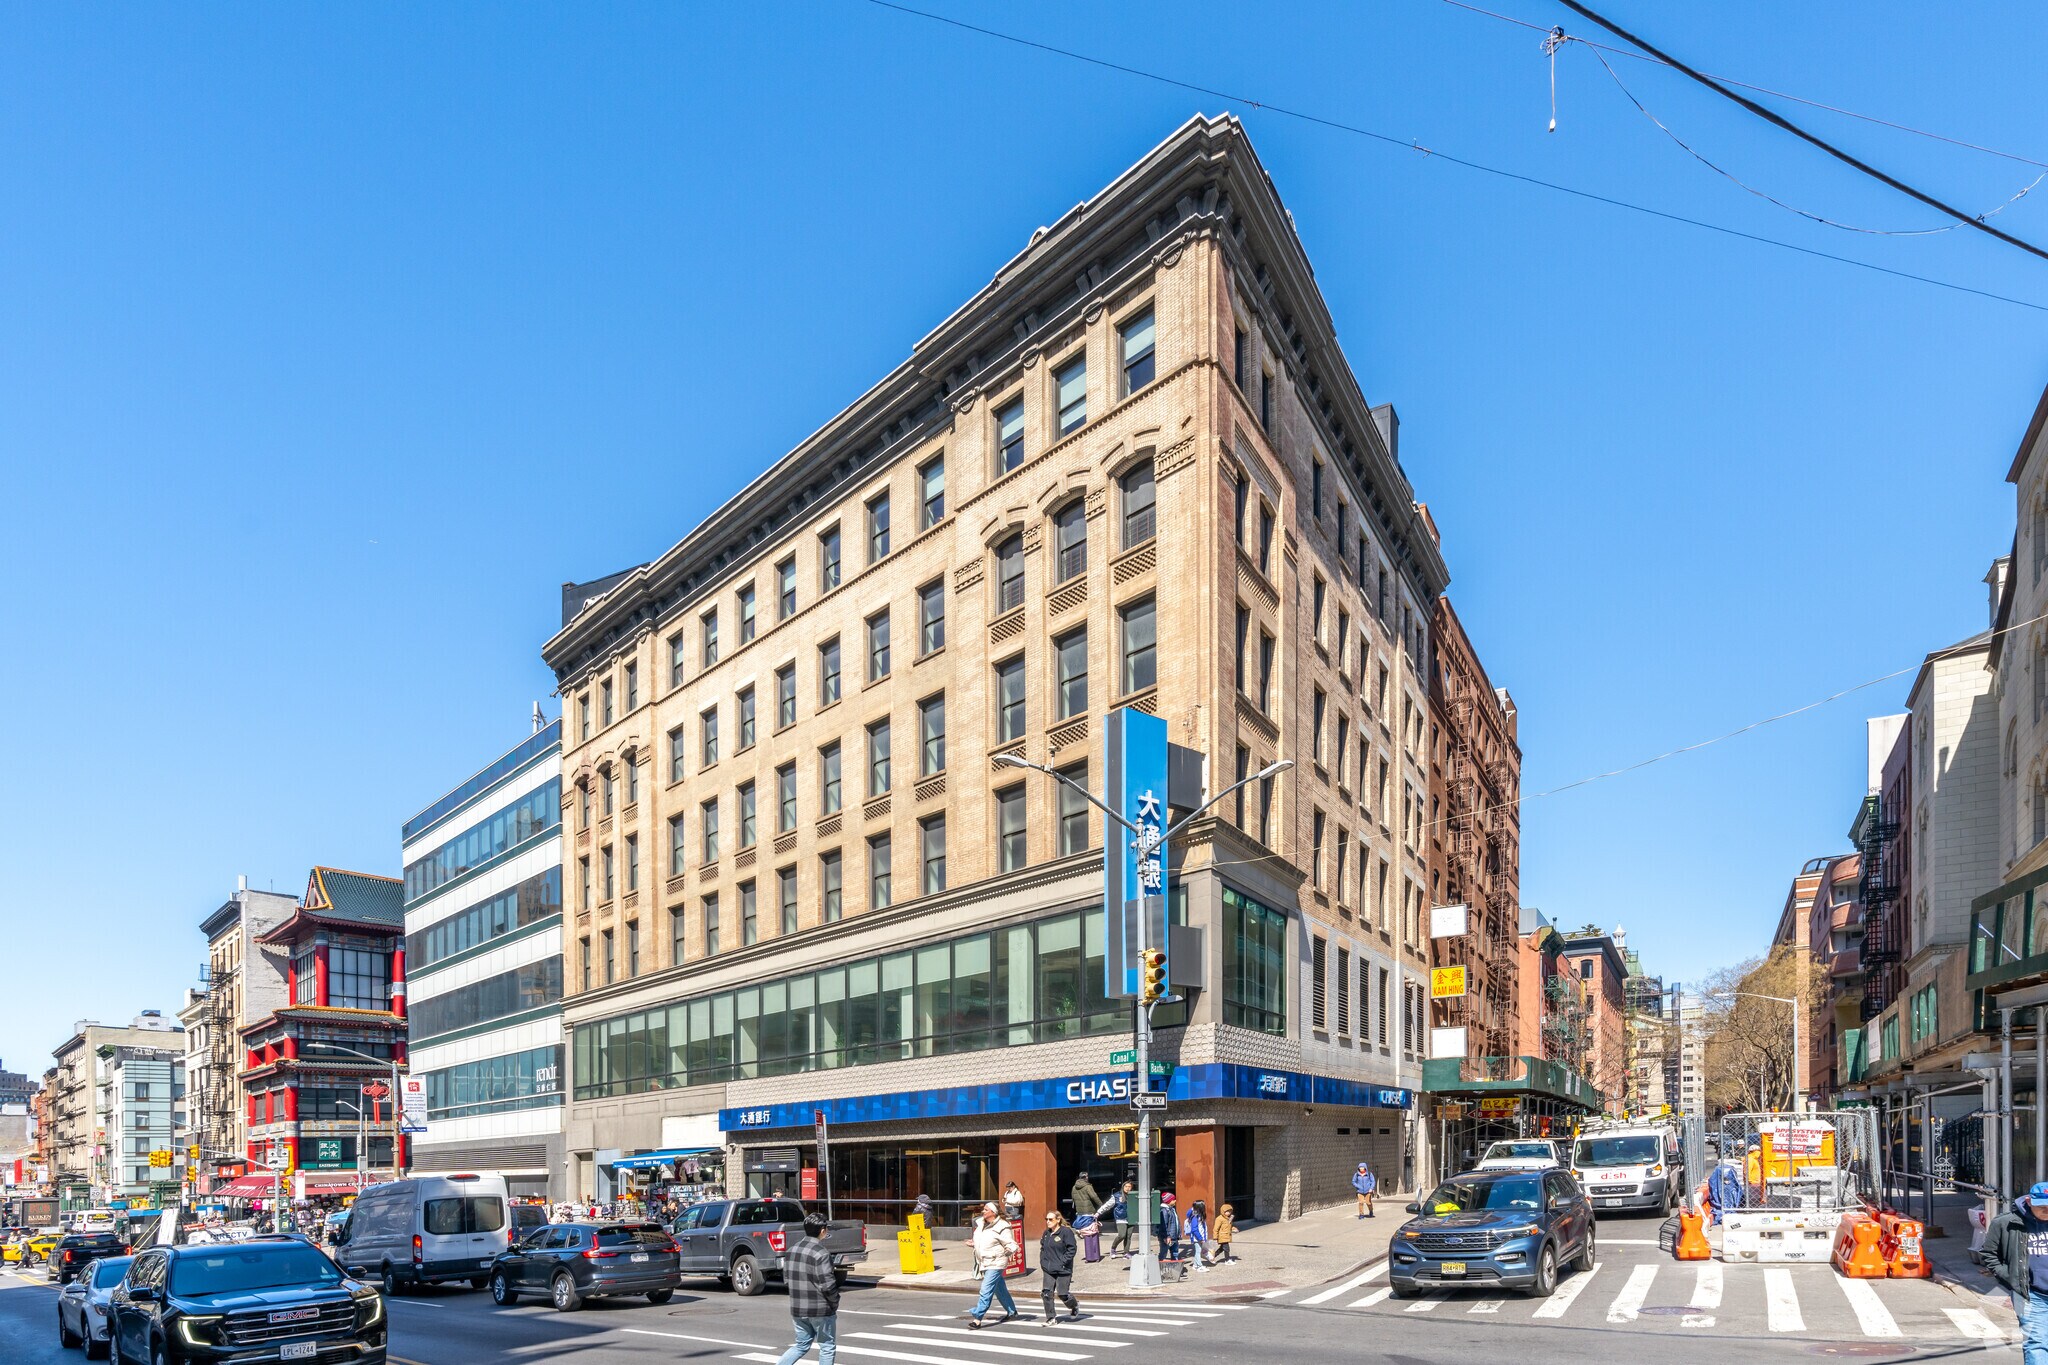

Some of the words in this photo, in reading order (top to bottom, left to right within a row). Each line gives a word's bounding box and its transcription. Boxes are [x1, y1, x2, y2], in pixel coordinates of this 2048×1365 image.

[1138, 789, 1162, 898] 大通銀
[1434, 970, 1464, 985] 金興
[1433, 986, 1447, 996] KAM
[1448, 984, 1464, 995] HING
[1112, 1052, 1129, 1064] Canal
[536, 1063, 557, 1082] rendr
[1150, 1063, 1166, 1073] Baxter
[1137, 1097, 1148, 1105] ONE
[1380, 1090, 1400, 1104] CHASE
[739, 1110, 771, 1124] 大通銀行
[1600, 1172, 1627, 1180] dish
[272, 1308, 318, 1321] GMC
